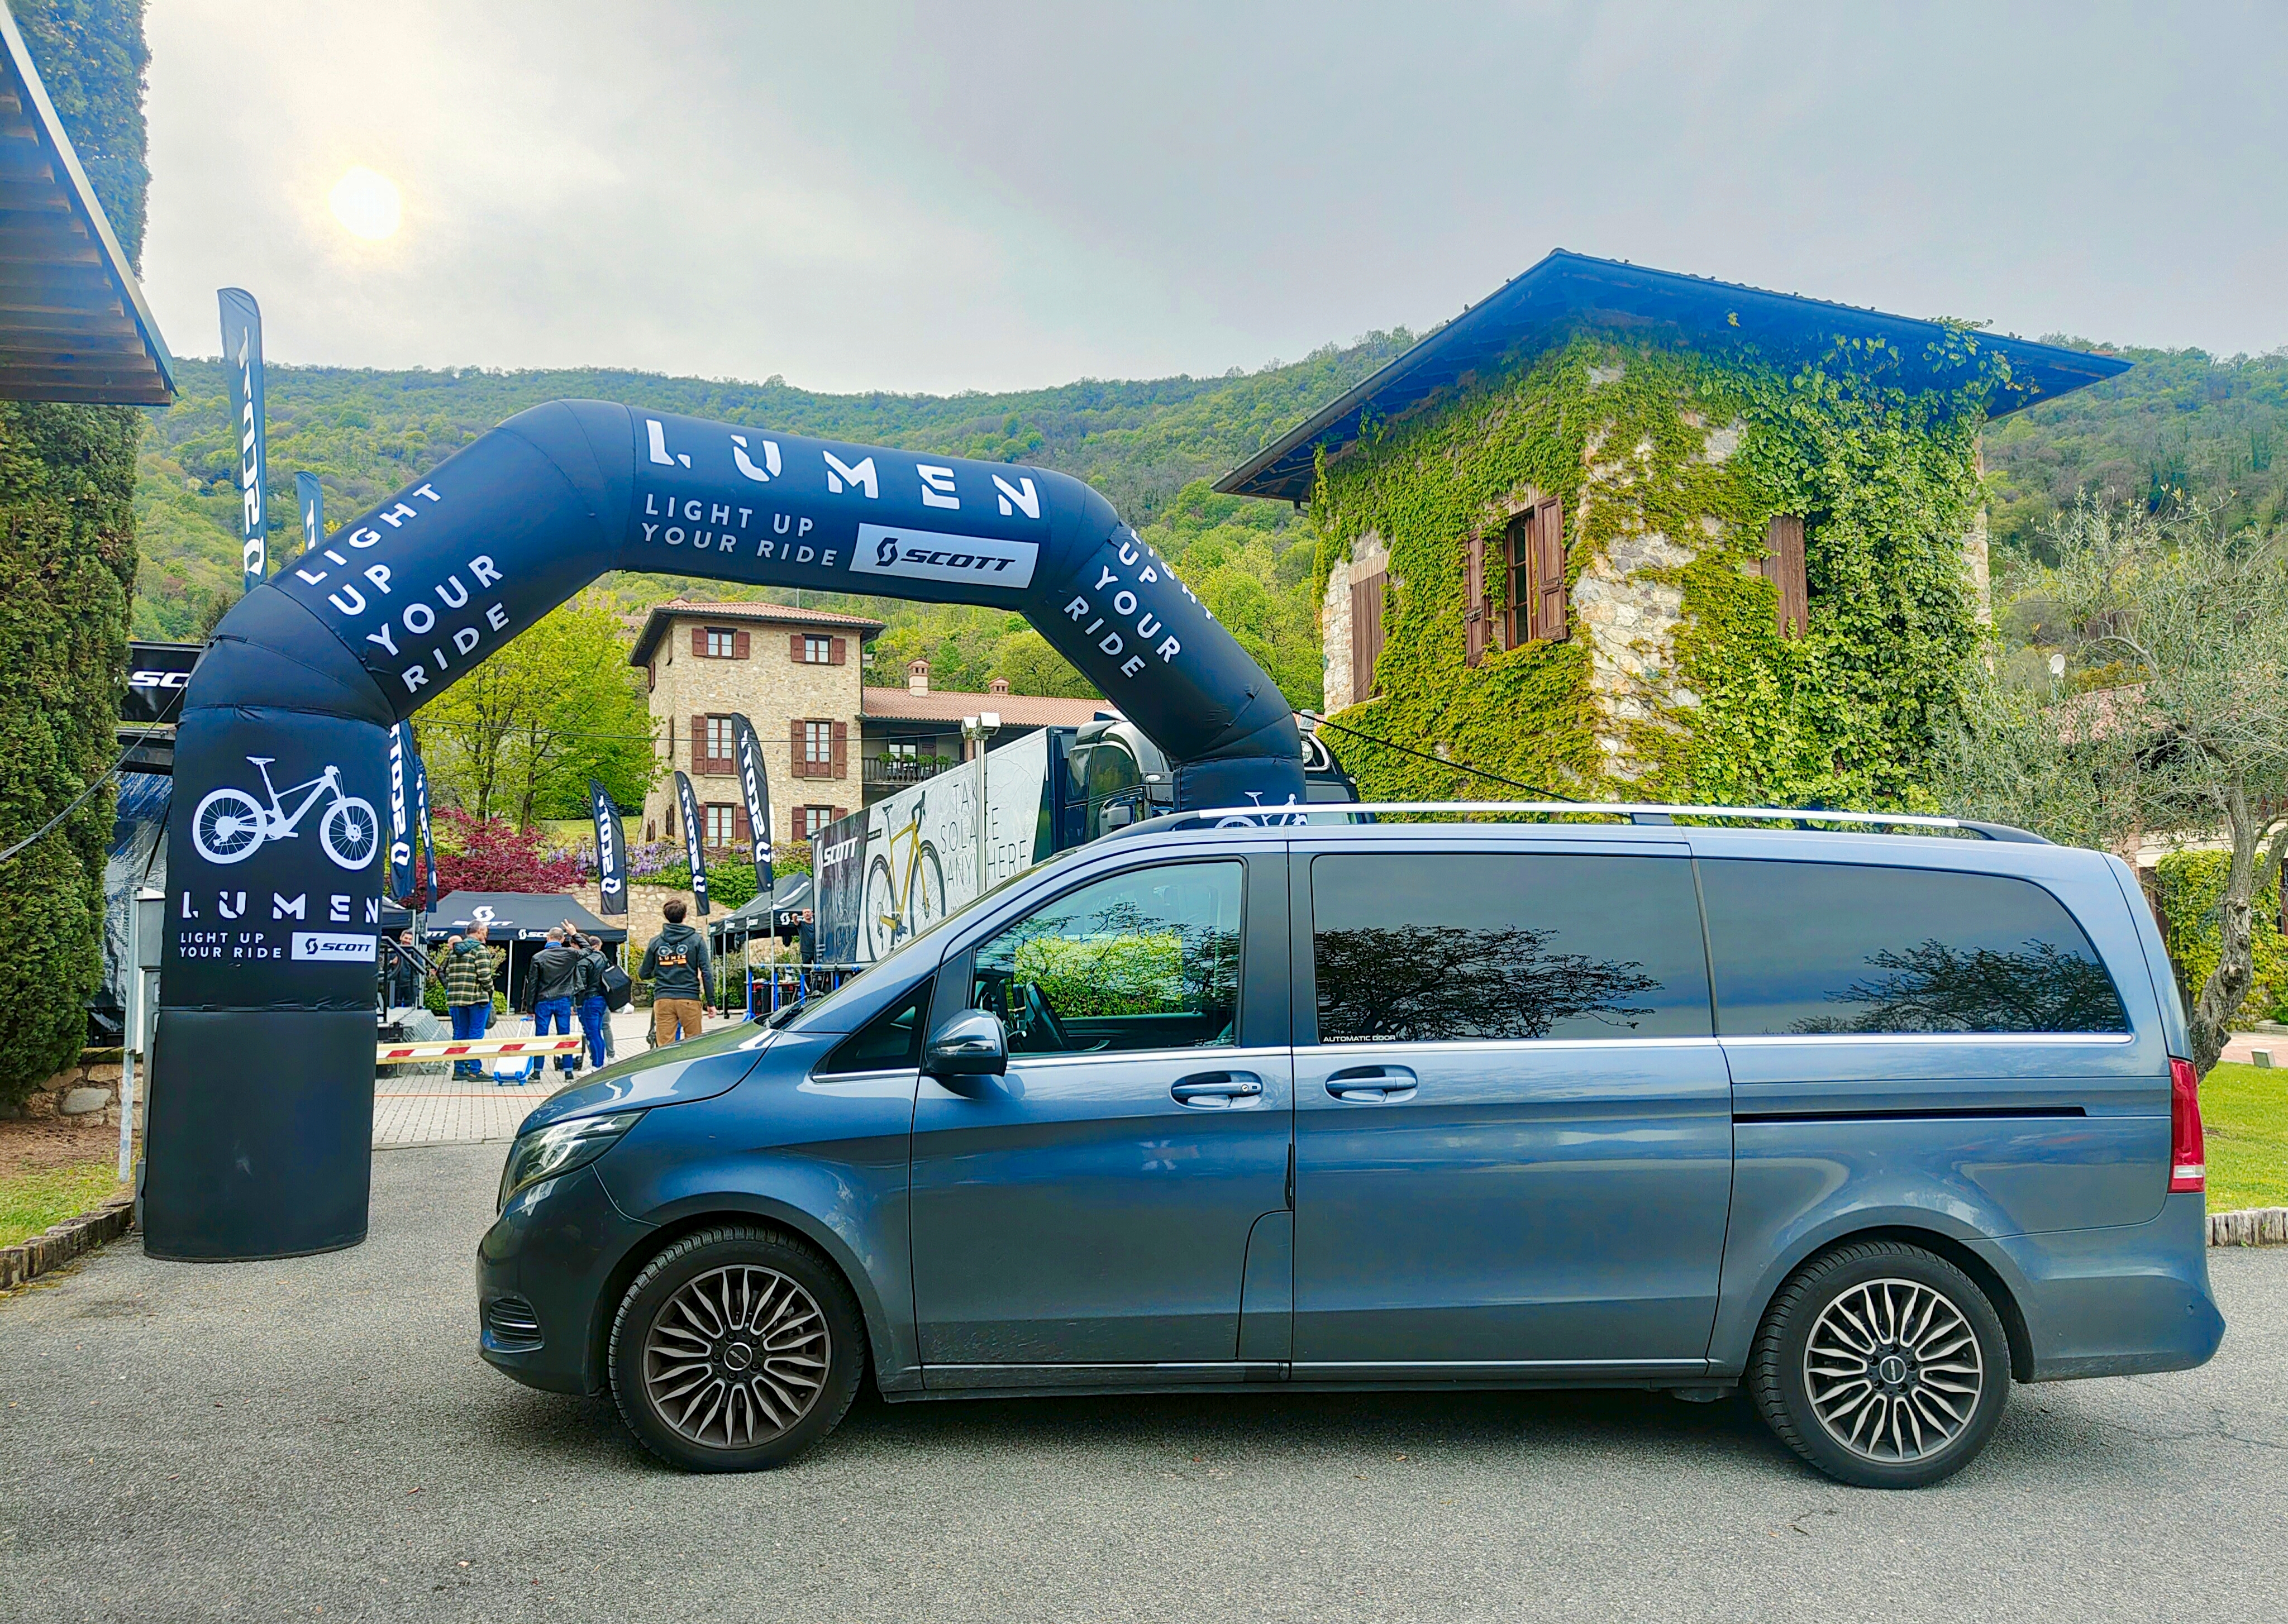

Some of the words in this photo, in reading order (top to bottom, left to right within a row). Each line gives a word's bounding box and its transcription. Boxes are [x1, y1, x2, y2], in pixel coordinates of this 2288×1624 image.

[646, 419, 1041, 519] LUMEN
[295, 483, 441, 585] LIGHT
[645, 494, 753, 529] LIGHT
[774, 513, 814, 537] UP
[642, 523, 737, 553] YOUR
[757, 539, 837, 566] RIDE
[900, 548, 1016, 572] SCOTT
[1118, 541, 1157, 583] UP
[328, 564, 392, 616] UP
[366, 555, 503, 656] YOUR
[1094, 565, 1181, 663] YOUR
[401, 603, 509, 694] RIDE
[1064, 595, 1146, 678] RIDE
[823, 837, 858, 867] SCOTT
[183, 891, 379, 924] LUMEN
[180, 932, 228, 944] LIGHT
[240, 933, 264, 944] UP
[180, 946, 222, 958] YOUR
[233, 947, 282, 958] RIDE
[320, 943, 371, 952] SCOTT
